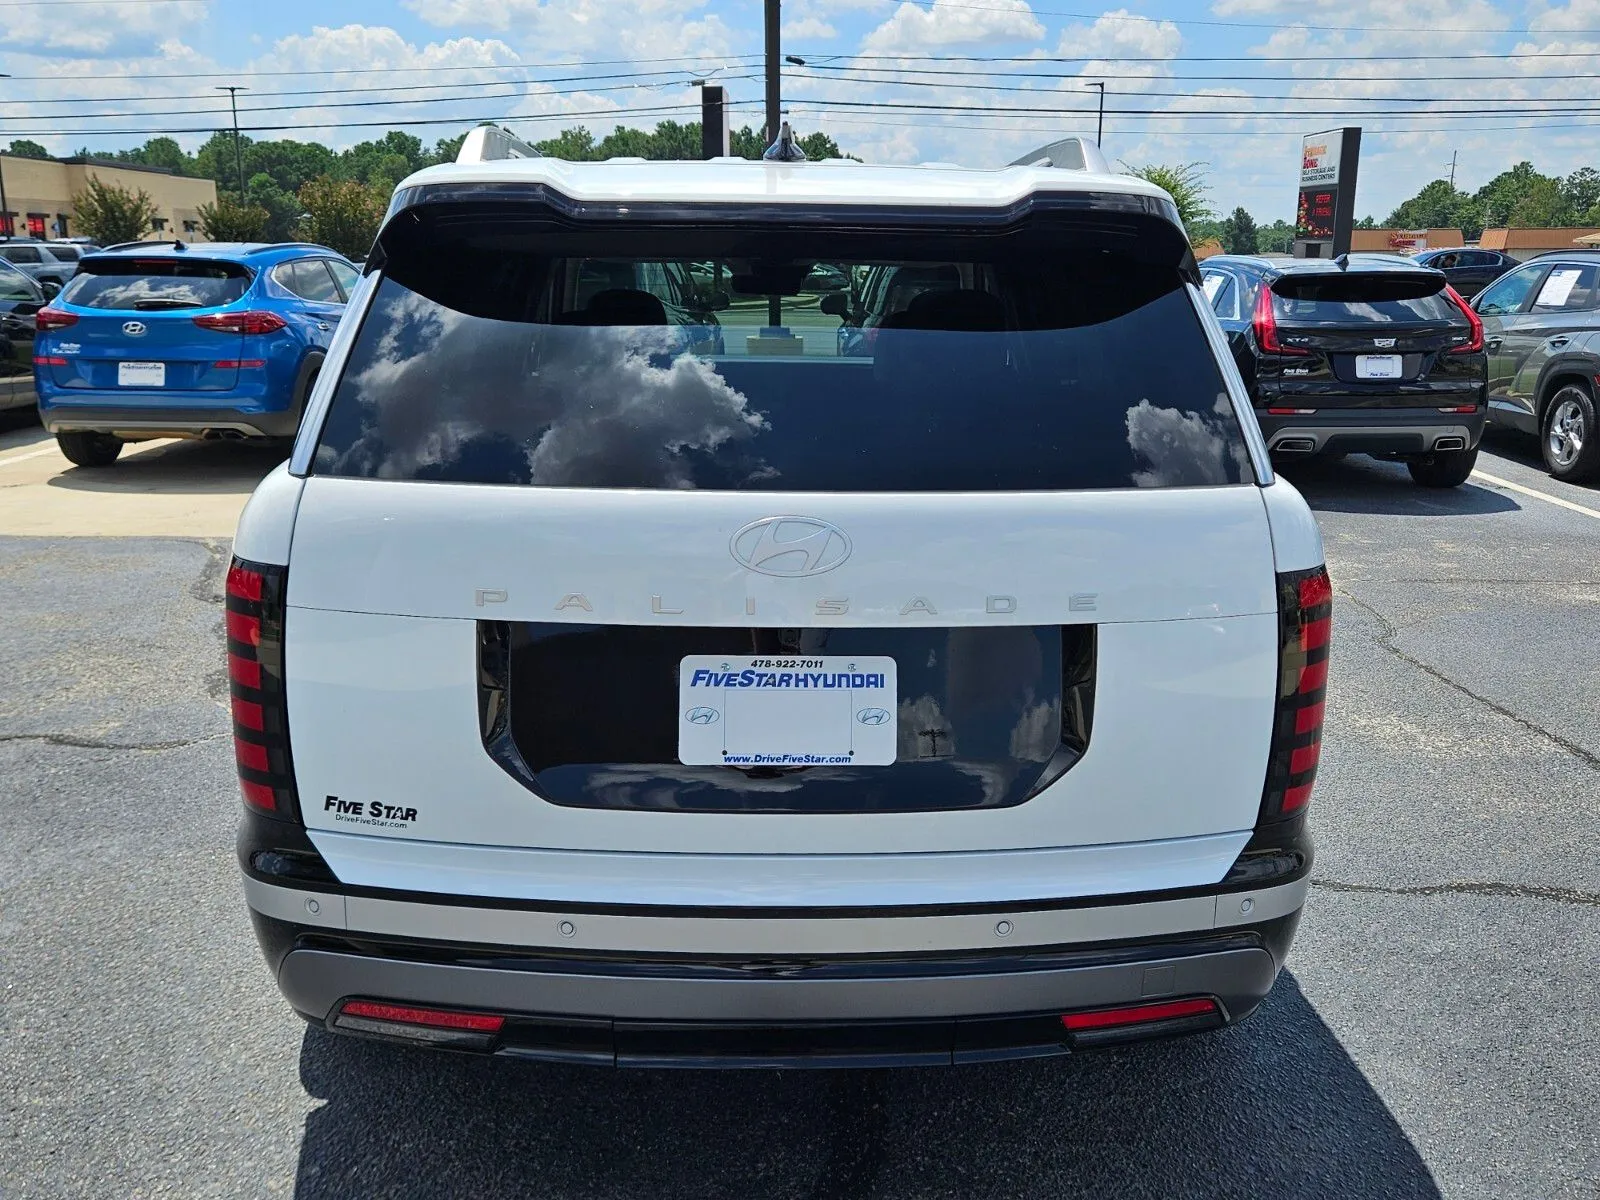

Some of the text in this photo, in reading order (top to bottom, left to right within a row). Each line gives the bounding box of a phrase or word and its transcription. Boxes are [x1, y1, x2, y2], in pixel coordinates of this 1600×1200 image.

[475, 588, 1099, 616] PALISADE
[750, 659, 825, 669] 478-922-7011
[723, 754, 852, 764] www.DriveFiveStar.com
[324, 795, 418, 822] FIVE STAR
[335, 814, 408, 829] DriveFiveStar.com
